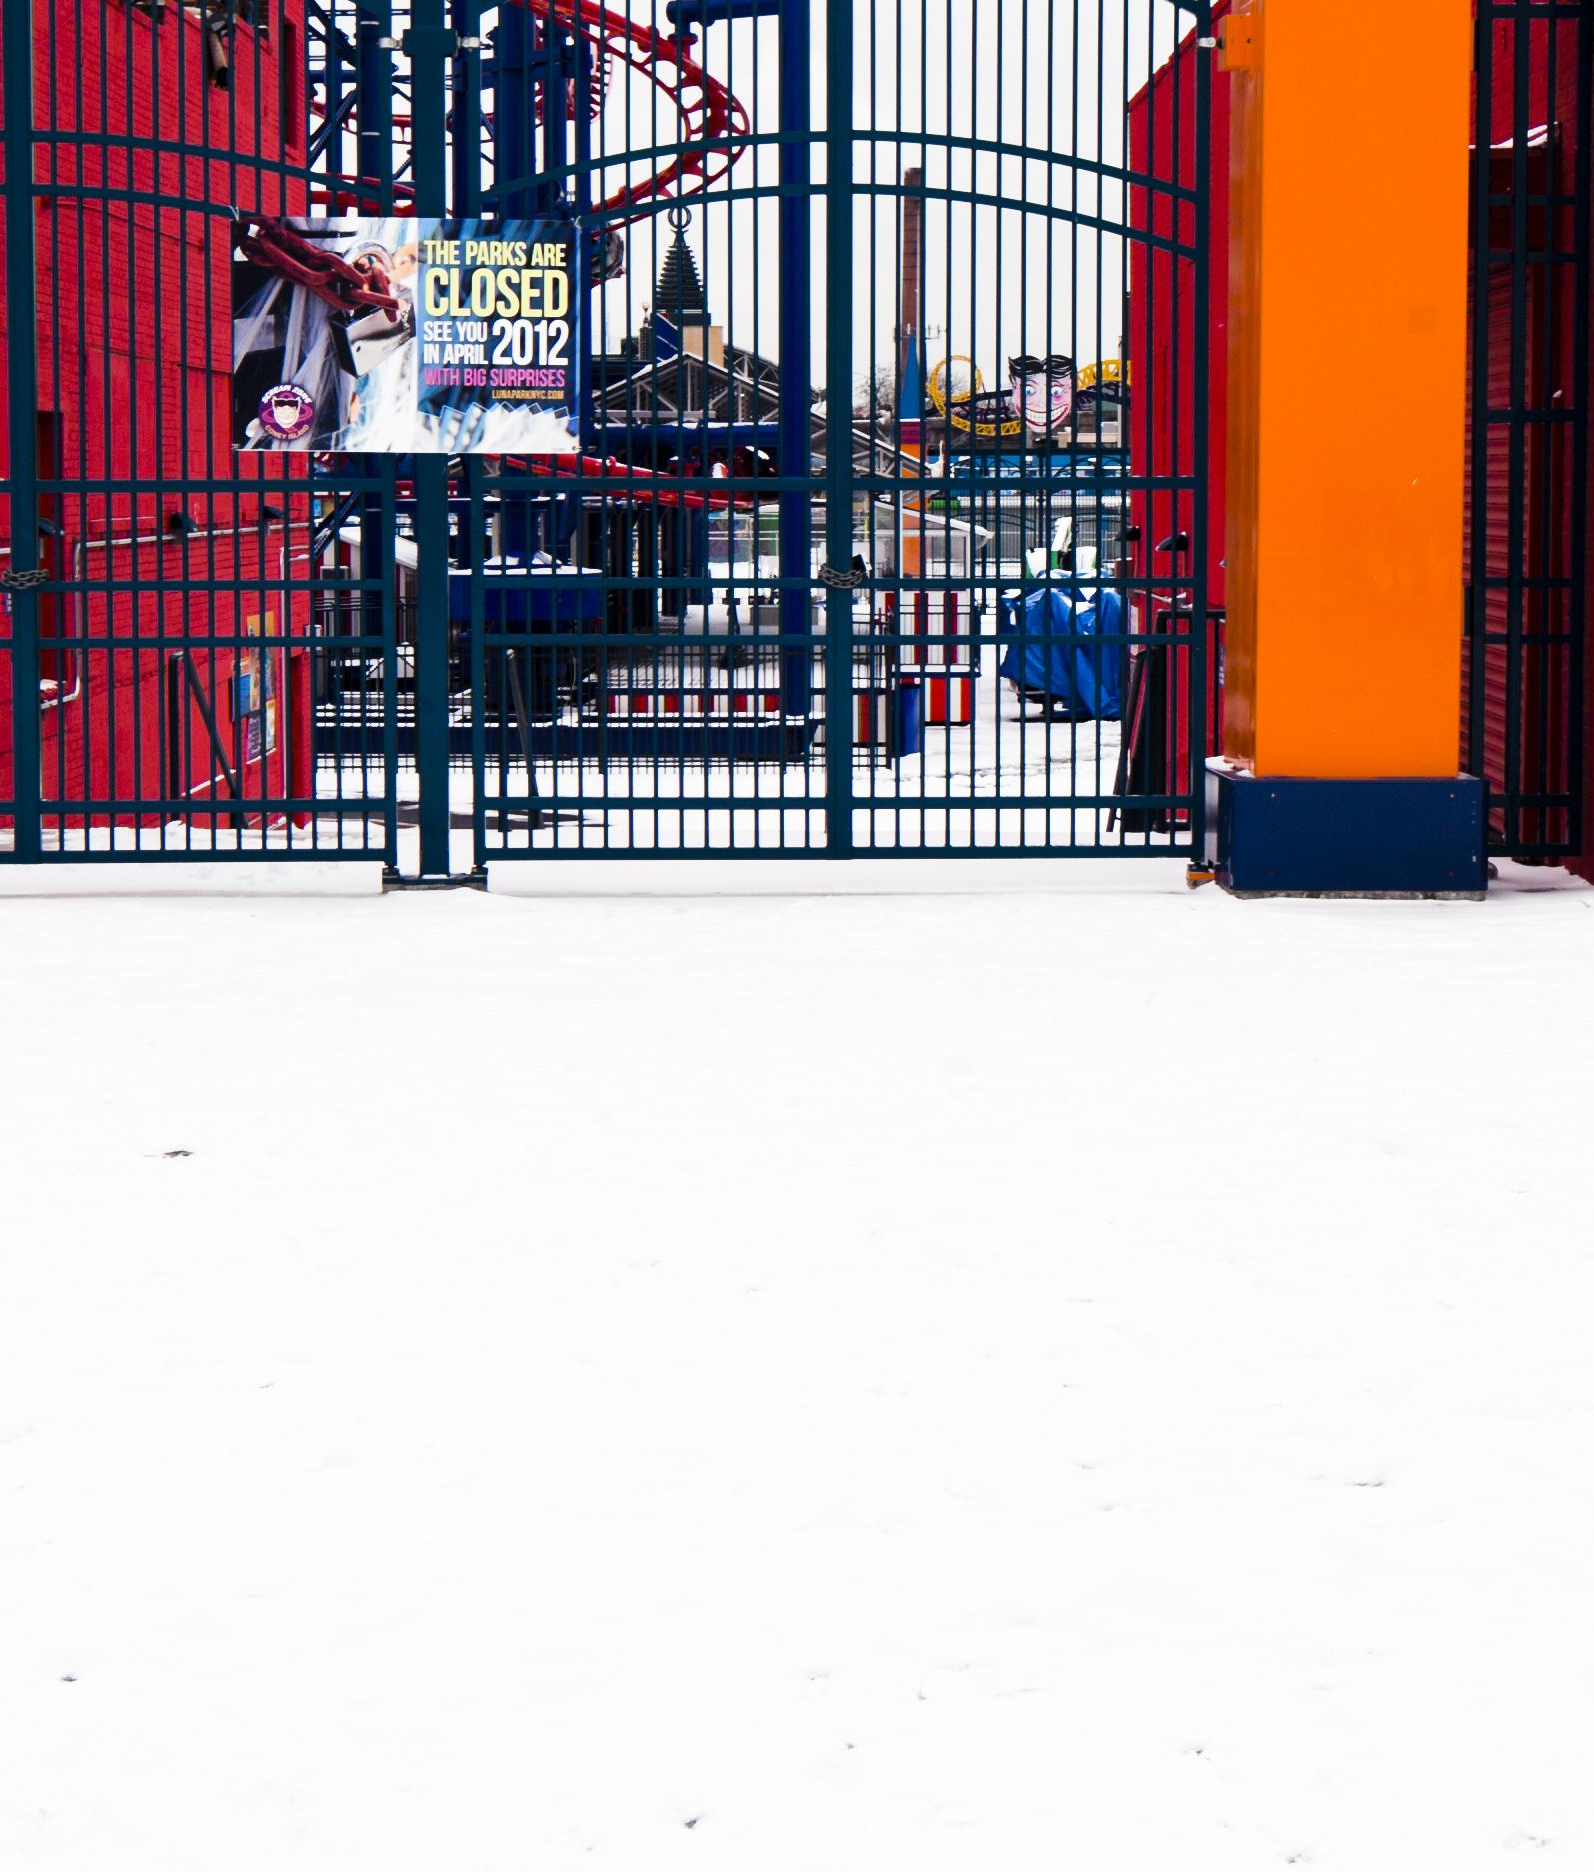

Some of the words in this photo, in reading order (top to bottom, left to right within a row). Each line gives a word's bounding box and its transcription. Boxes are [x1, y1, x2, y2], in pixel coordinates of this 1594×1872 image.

[424, 240, 461, 265] THE
[466, 241, 527, 266] PARKS
[531, 243, 566, 267] ARE
[425, 267, 569, 318] CLOSED
[424, 321, 453, 342] SEE
[456, 321, 488, 342] YOU
[492, 319, 569, 366] 2012
[424, 344, 440, 364] IN
[443, 344, 489, 365] APRIL
[424, 368, 461, 387] WITH
[464, 368, 487, 387] BIG
[490, 369, 566, 387] SURPRISES
